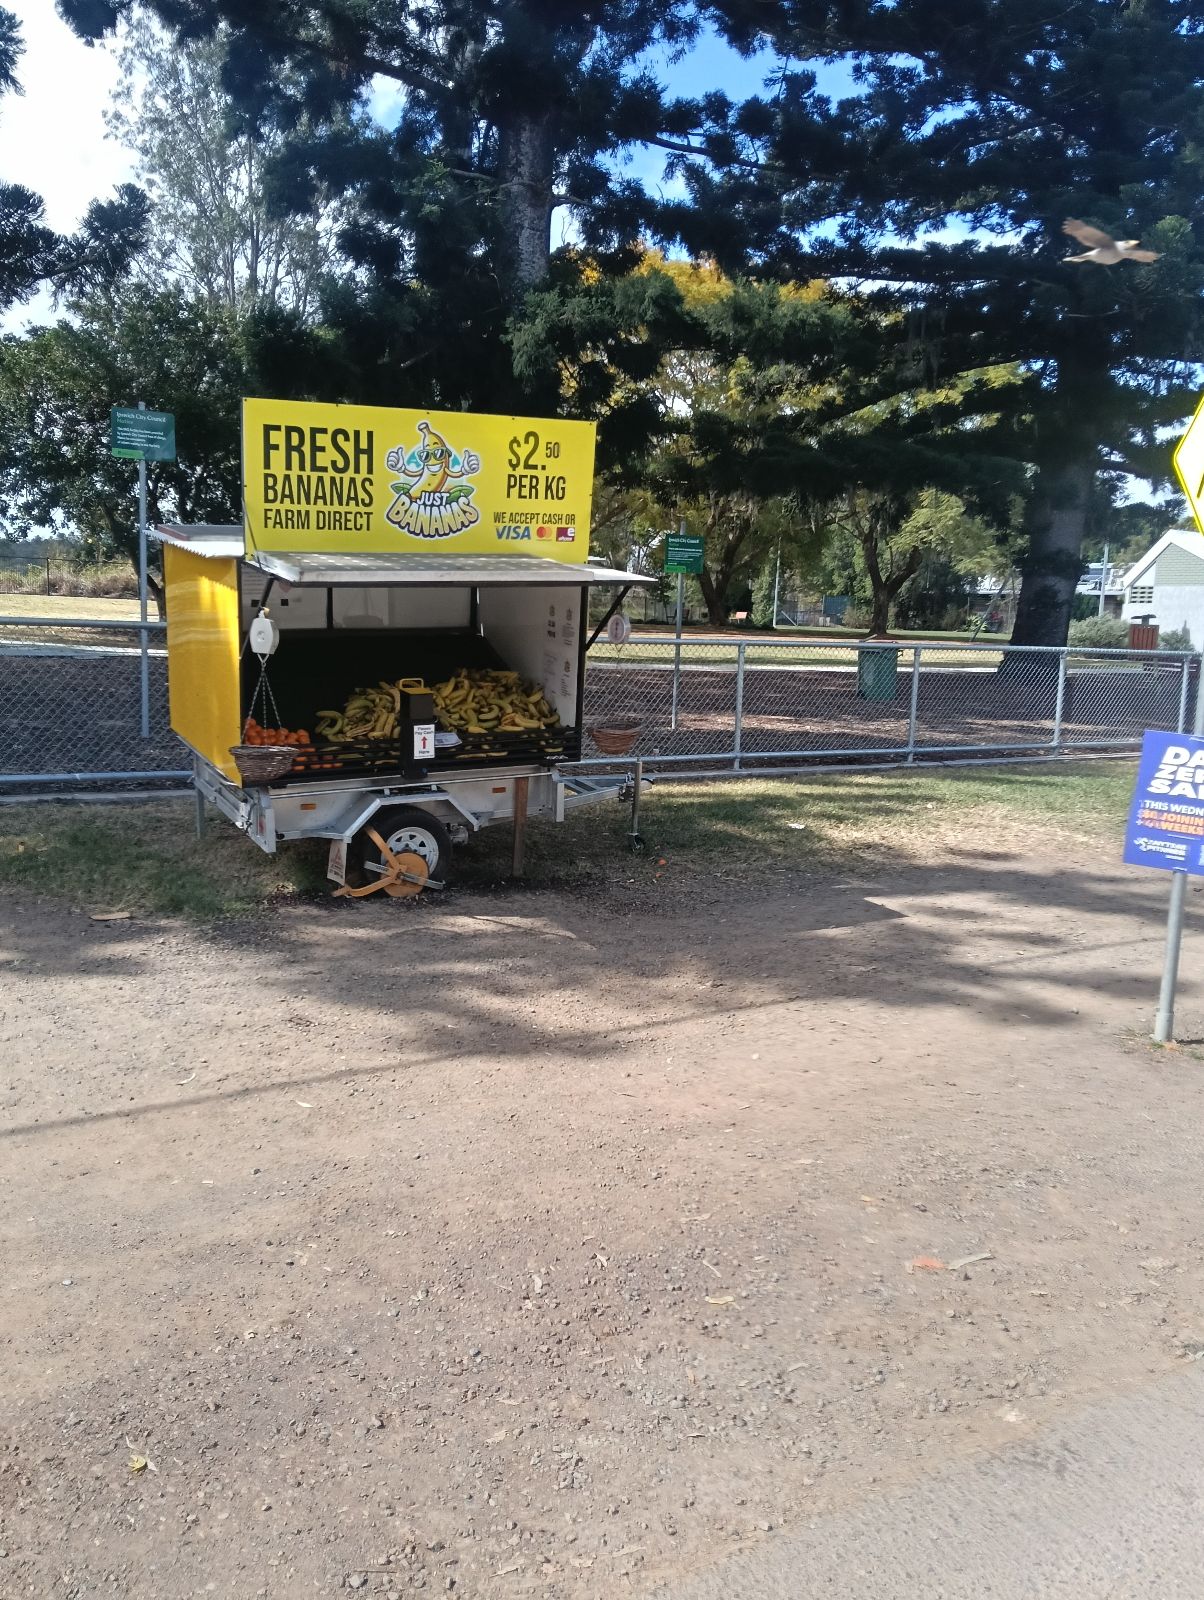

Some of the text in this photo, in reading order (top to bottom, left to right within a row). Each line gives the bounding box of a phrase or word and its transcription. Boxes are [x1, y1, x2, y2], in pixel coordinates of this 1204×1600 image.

[263, 424, 373, 475] FRESH
[263, 473, 374, 508] BANANAS
[506, 474, 566, 501] PER KG
[417, 491, 450, 505] JUST
[263, 508, 373, 531] FARM DIRECT
[387, 493, 479, 537] BANANAS
[493, 512, 576, 525] WE ACCEPT CASH OR
[495, 525, 531, 540] VISA
[1144, 800, 1169, 811] THIS
[1161, 822, 1204, 836] WEEKS
